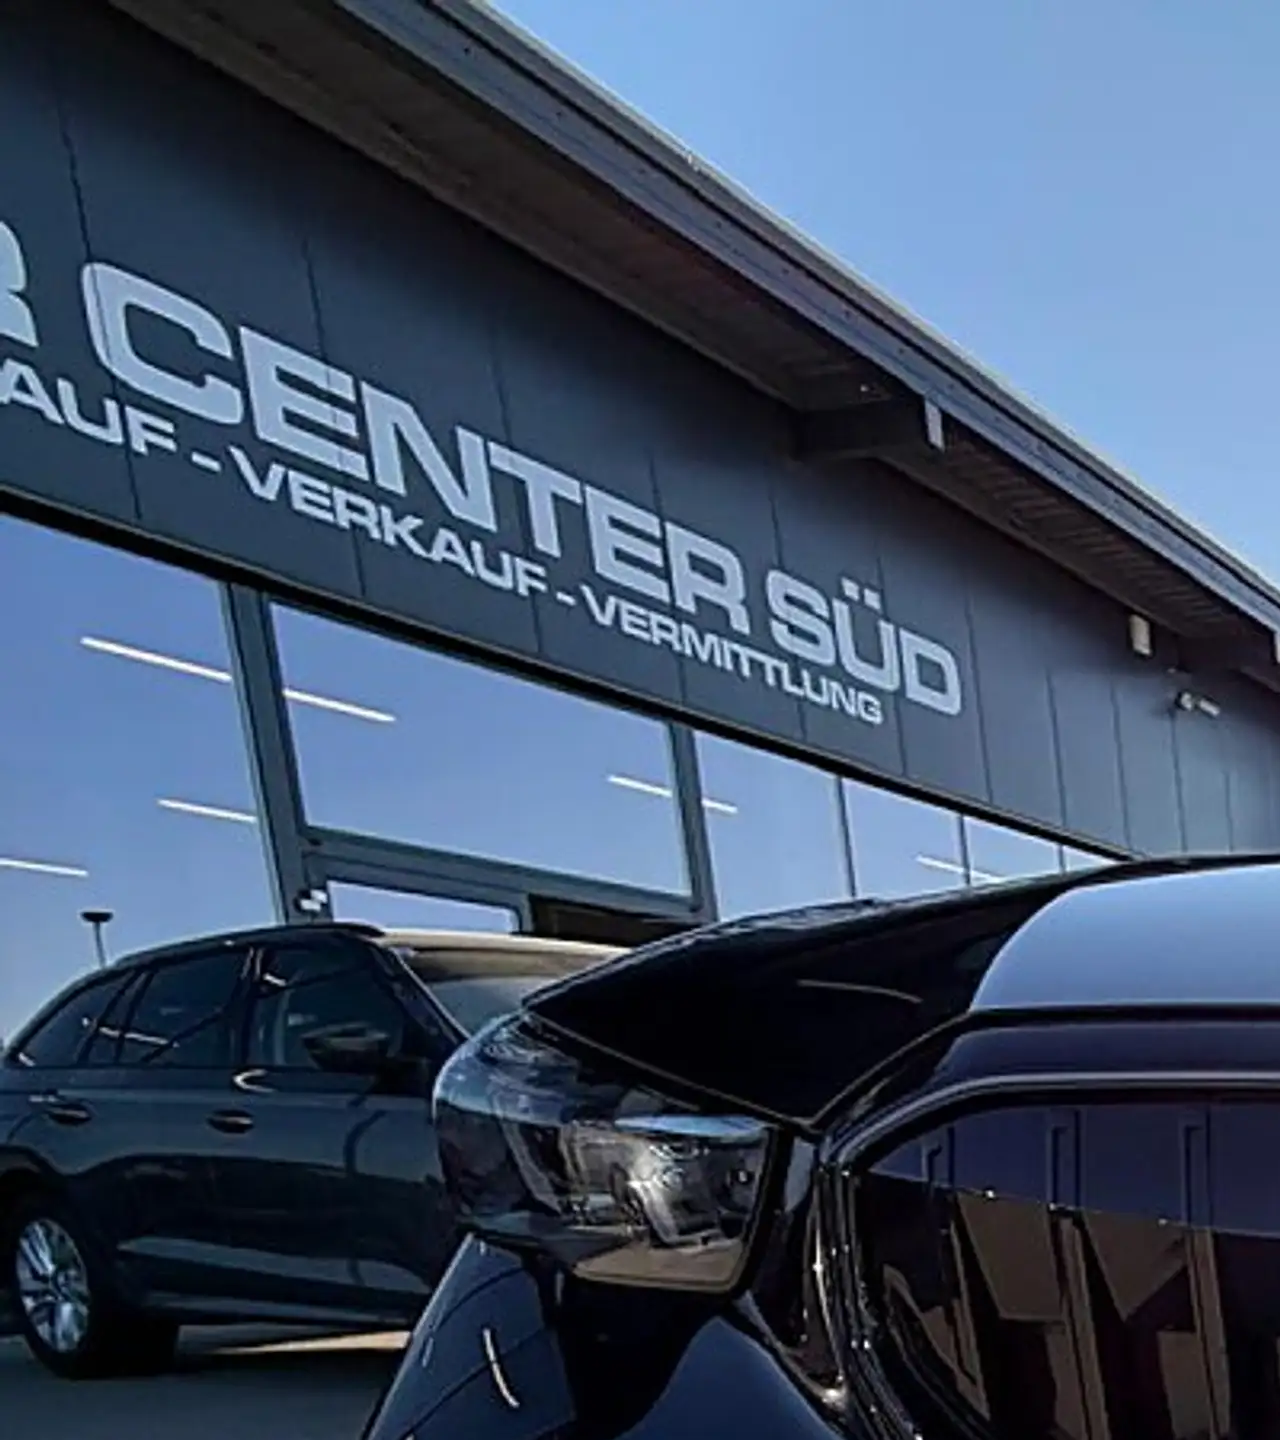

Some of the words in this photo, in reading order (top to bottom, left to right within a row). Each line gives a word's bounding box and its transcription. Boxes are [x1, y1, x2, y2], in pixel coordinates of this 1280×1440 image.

[82, 262, 750, 636] CENTER
[766, 570, 962, 717] SÜD
[229, 445, 548, 597] VERKAUF
[580, 584, 884, 725] VERMITTLUNG
